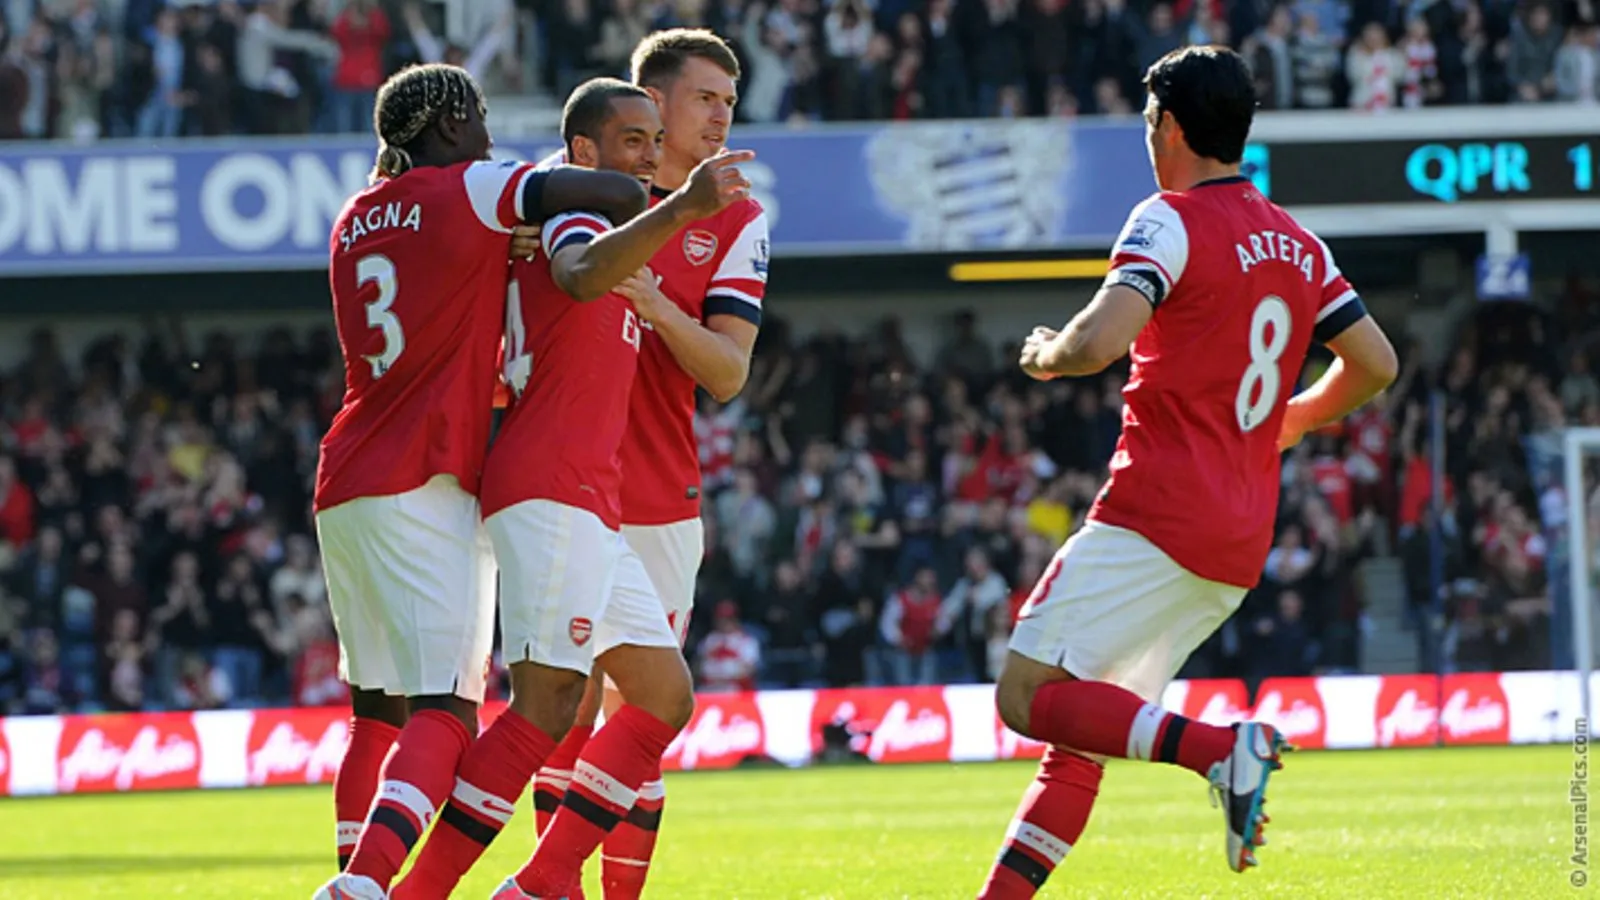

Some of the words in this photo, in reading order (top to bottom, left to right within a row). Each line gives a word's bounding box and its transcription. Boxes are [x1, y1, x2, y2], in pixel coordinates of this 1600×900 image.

[0, 156, 178, 253] ME
[202, 151, 378, 251] ON
[1405, 143, 1531, 203] QPR
[1567, 143, 1592, 191] 1
[339, 200, 422, 252] SAGNA
[1235, 230, 1315, 283] ARTETA
[355, 254, 405, 379] 3
[504, 278, 534, 398] 4
[1235, 294, 1292, 432] 8
